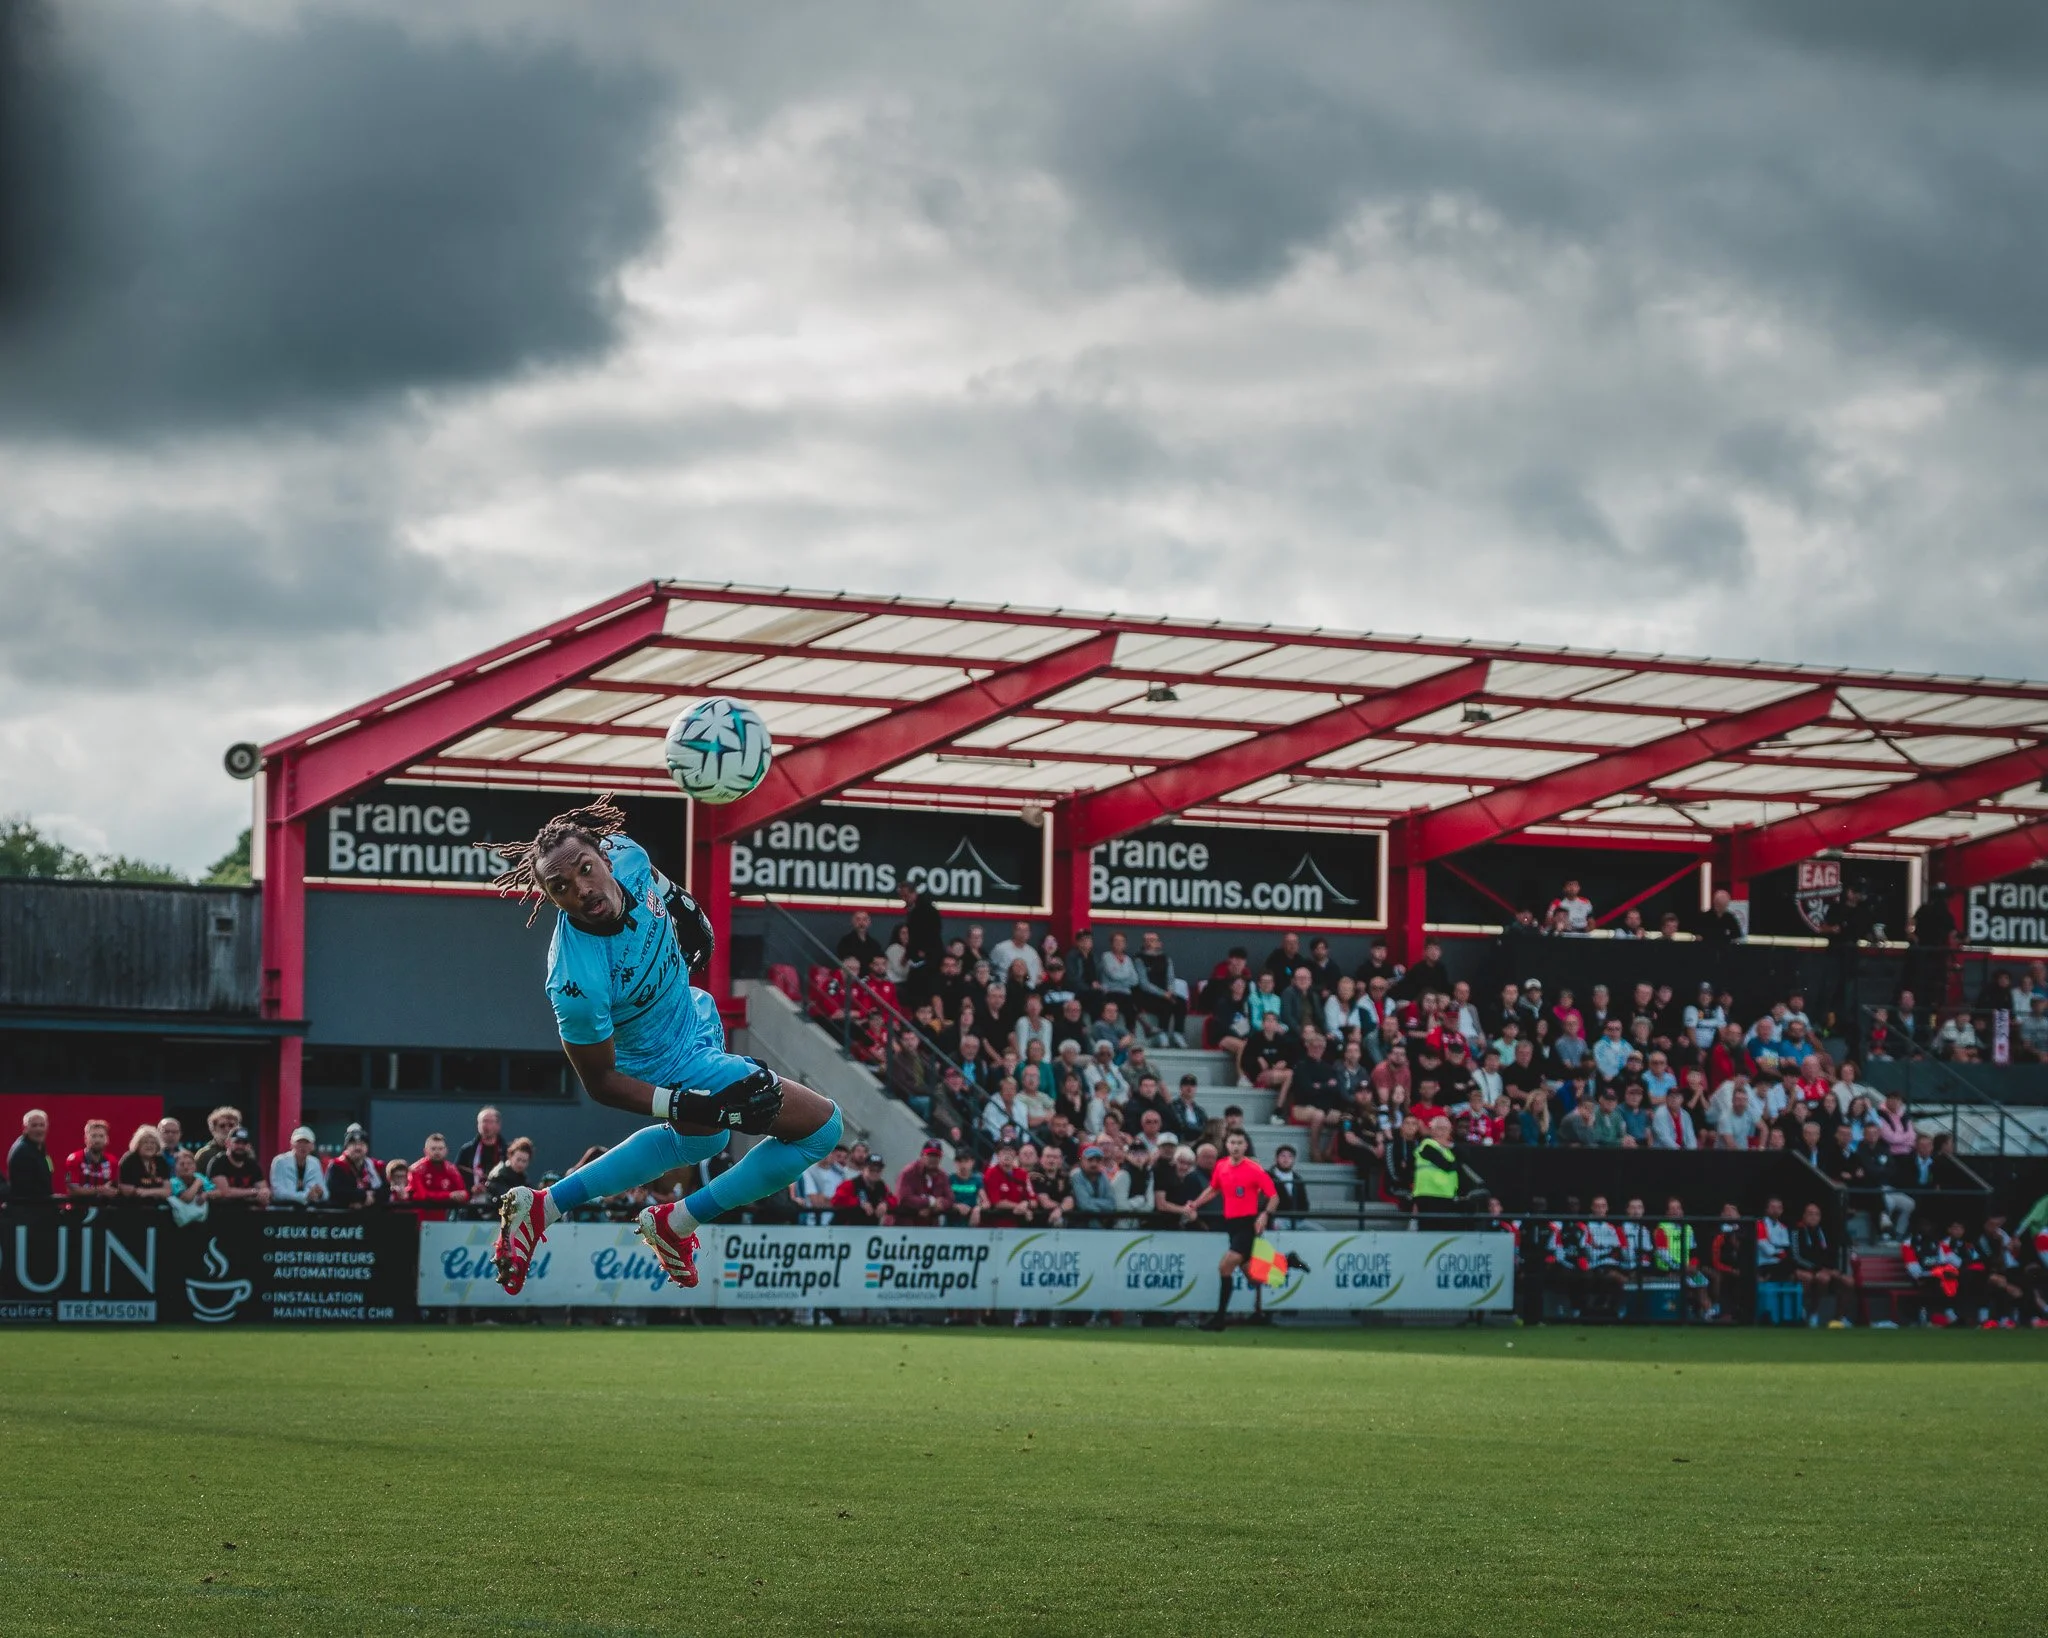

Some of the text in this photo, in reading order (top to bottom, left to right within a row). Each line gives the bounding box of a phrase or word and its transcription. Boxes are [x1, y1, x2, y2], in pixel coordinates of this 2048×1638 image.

[731, 844, 982, 897] Barnumscom
[1801, 863, 1837, 889] EAG
[1089, 864, 1323, 912] Barnums.com
[1969, 882, 2048, 910] Franc
[275, 1225, 364, 1240] JEUX DE CAFÉ
[0, 1206, 157, 1294] UÍN
[274, 1251, 376, 1265] DISTRIBUTEURS
[724, 1233, 852, 1268] Guingamp
[866, 1234, 990, 1270] Guingamp
[1020, 1251, 1081, 1271] GROUPE
[1127, 1252, 1186, 1273] GROUPE
[1335, 1253, 1392, 1273] GROUPE
[1437, 1253, 1493, 1272] GROUPE
[273, 1266, 372, 1280] AUTOMATIQUES
[737, 1260, 841, 1297] Paimpol
[878, 1261, 979, 1298] Paimpol
[1021, 1271, 1034, 1287] LE
[1127, 1273, 1140, 1288] LE
[1336, 1274, 1349, 1288] LE
[1437, 1274, 1450, 1289] LE
[273, 1291, 364, 1304] INSTALLATION
[0, 1302, 52, 1317] culiers
[63, 1300, 149, 1319] TRÉMUSON
[273, 1306, 365, 1319] MAINTENANCE
